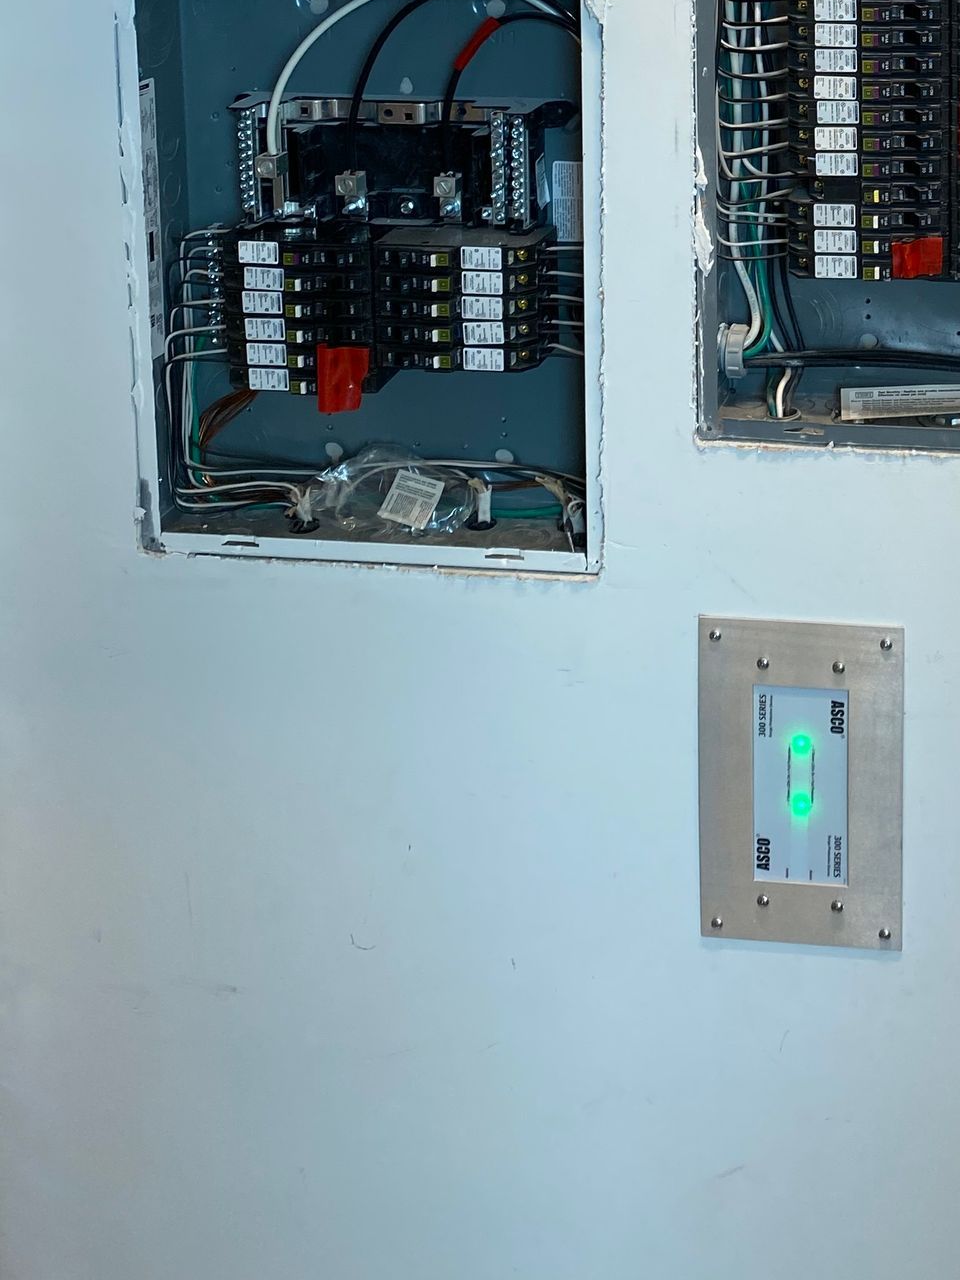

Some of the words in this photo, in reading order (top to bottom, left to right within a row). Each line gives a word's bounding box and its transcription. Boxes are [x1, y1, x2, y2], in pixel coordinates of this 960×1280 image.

[758, 694, 767, 720] SERIES
[830, 700, 844, 735] ASCO
[758, 721, 767, 738] 300
[756, 837, 771, 871] ASCO
[833, 835, 842, 851] 300
[833, 851, 842, 878] SERIES
